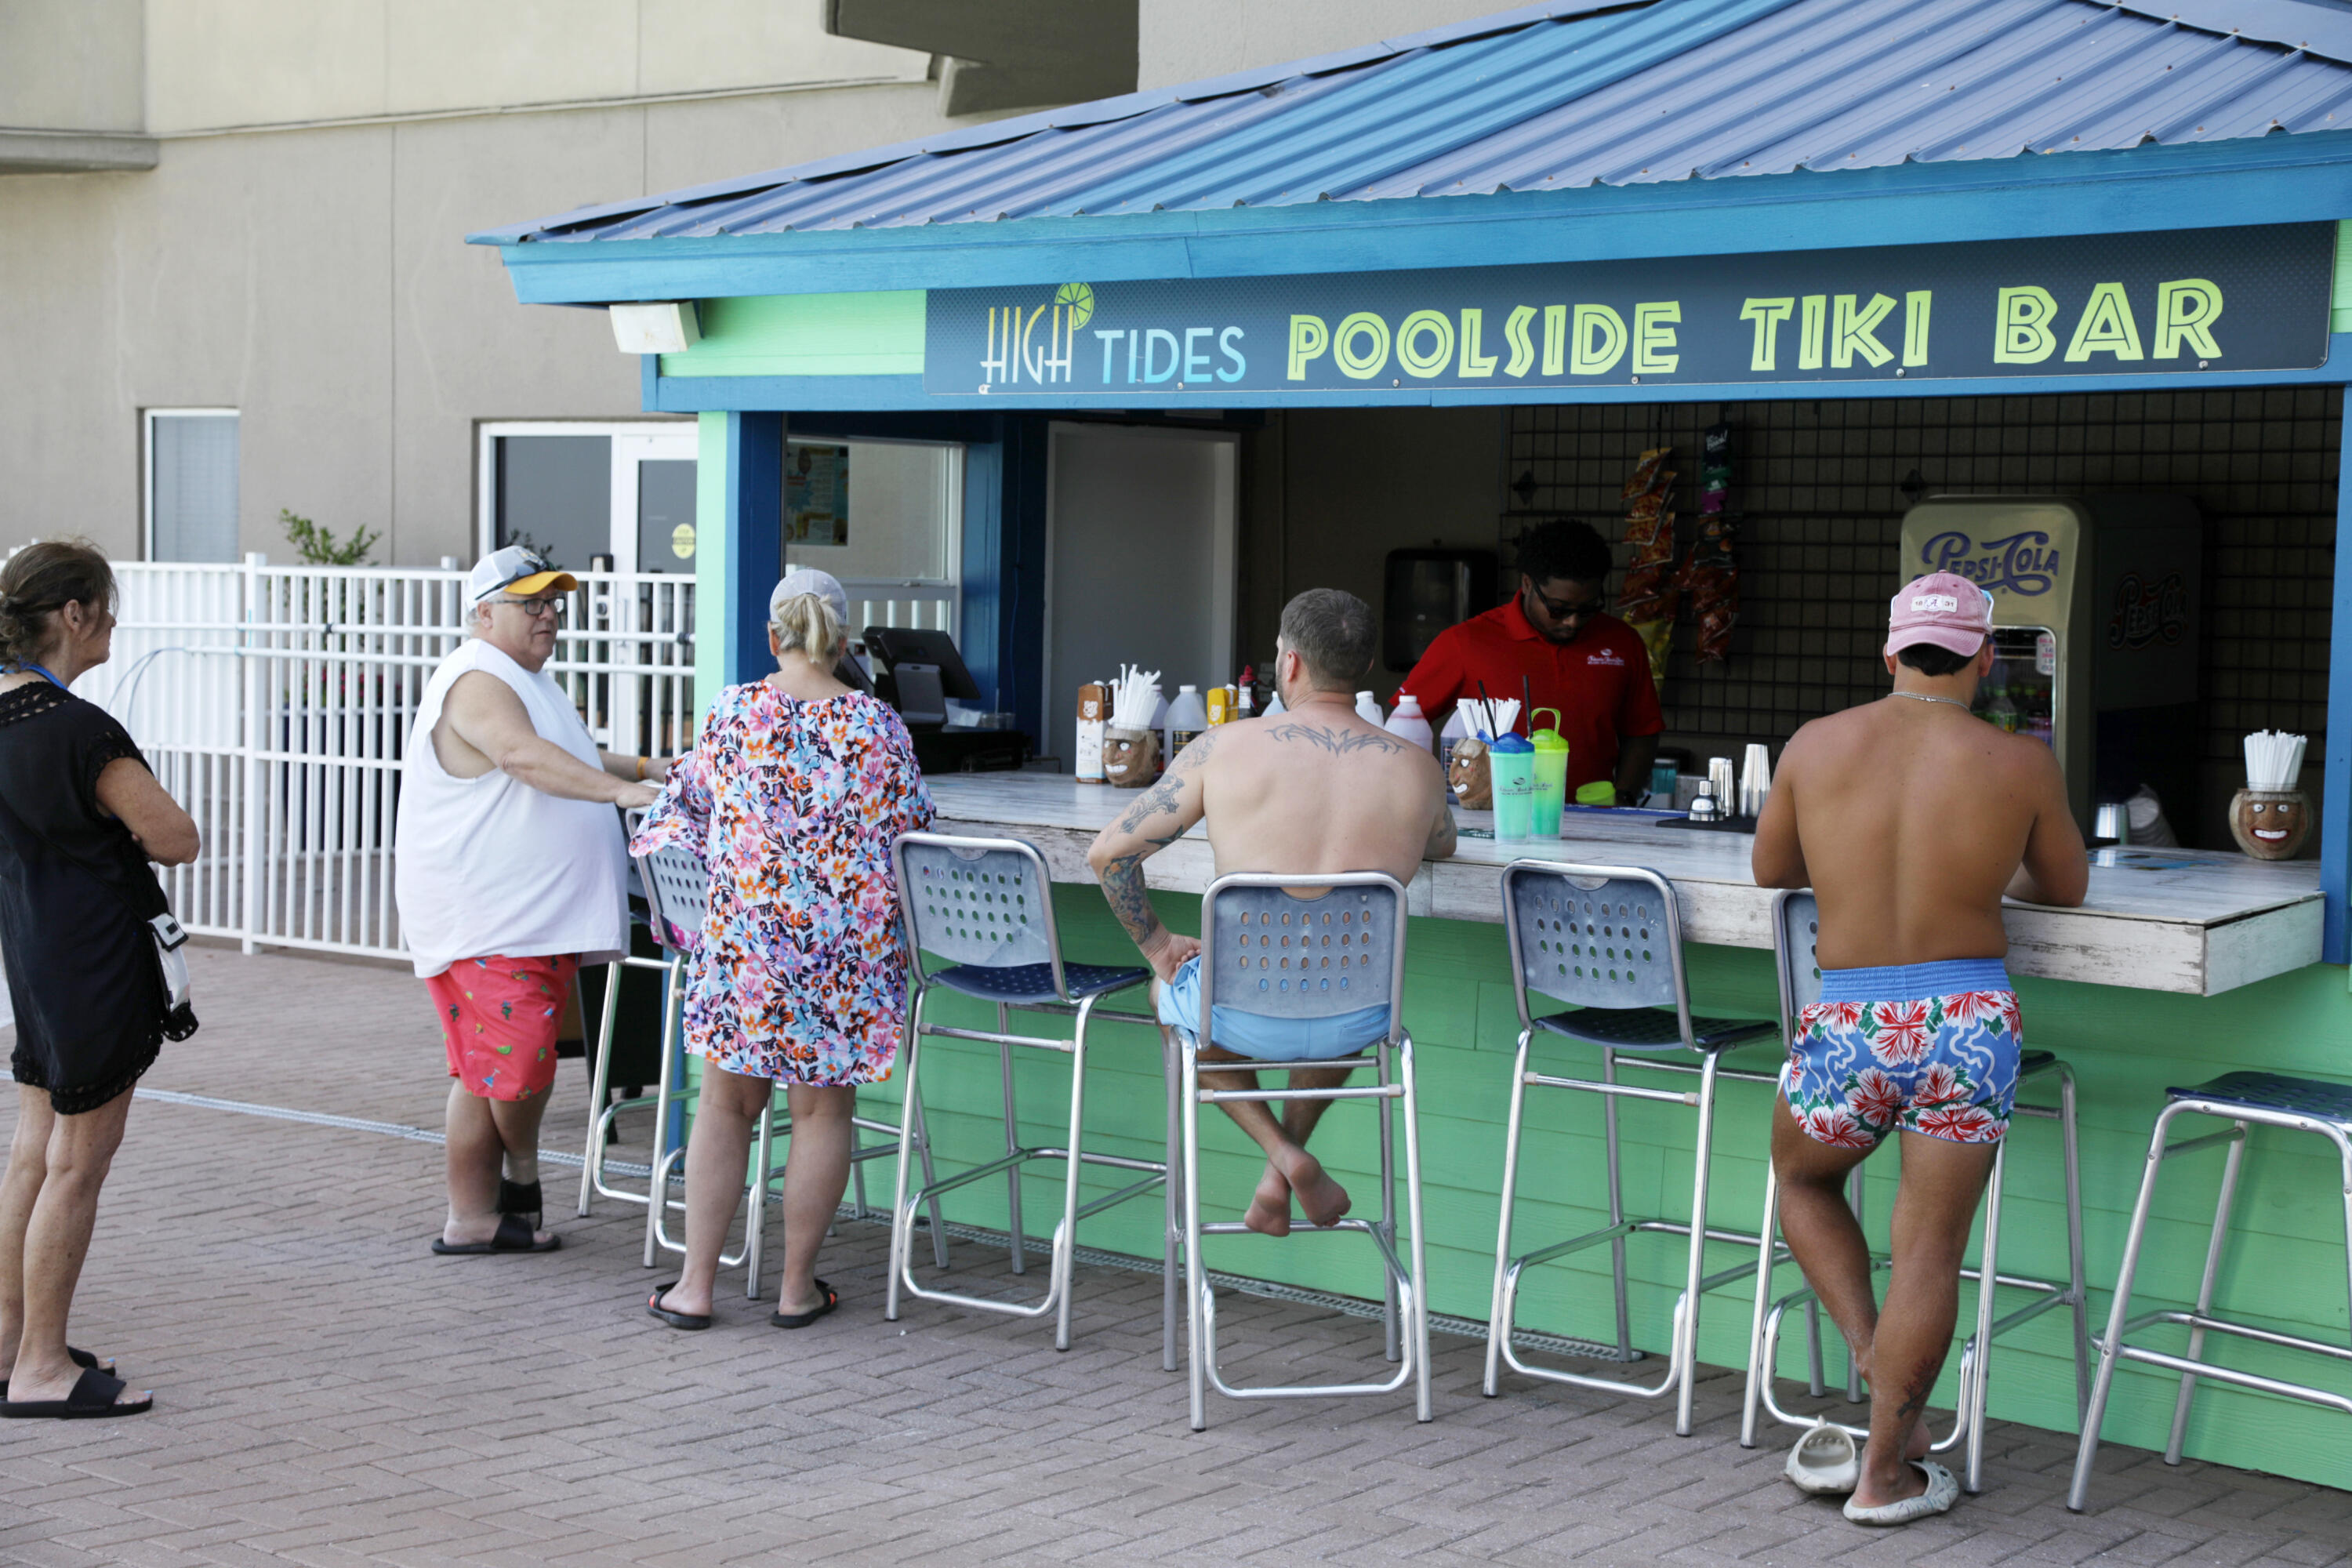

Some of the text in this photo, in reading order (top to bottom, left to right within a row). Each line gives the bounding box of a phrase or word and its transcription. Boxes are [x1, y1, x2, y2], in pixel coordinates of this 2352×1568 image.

[979, 278, 2225, 386] HIGH TIDES POOLSIDE TIKI BAR
